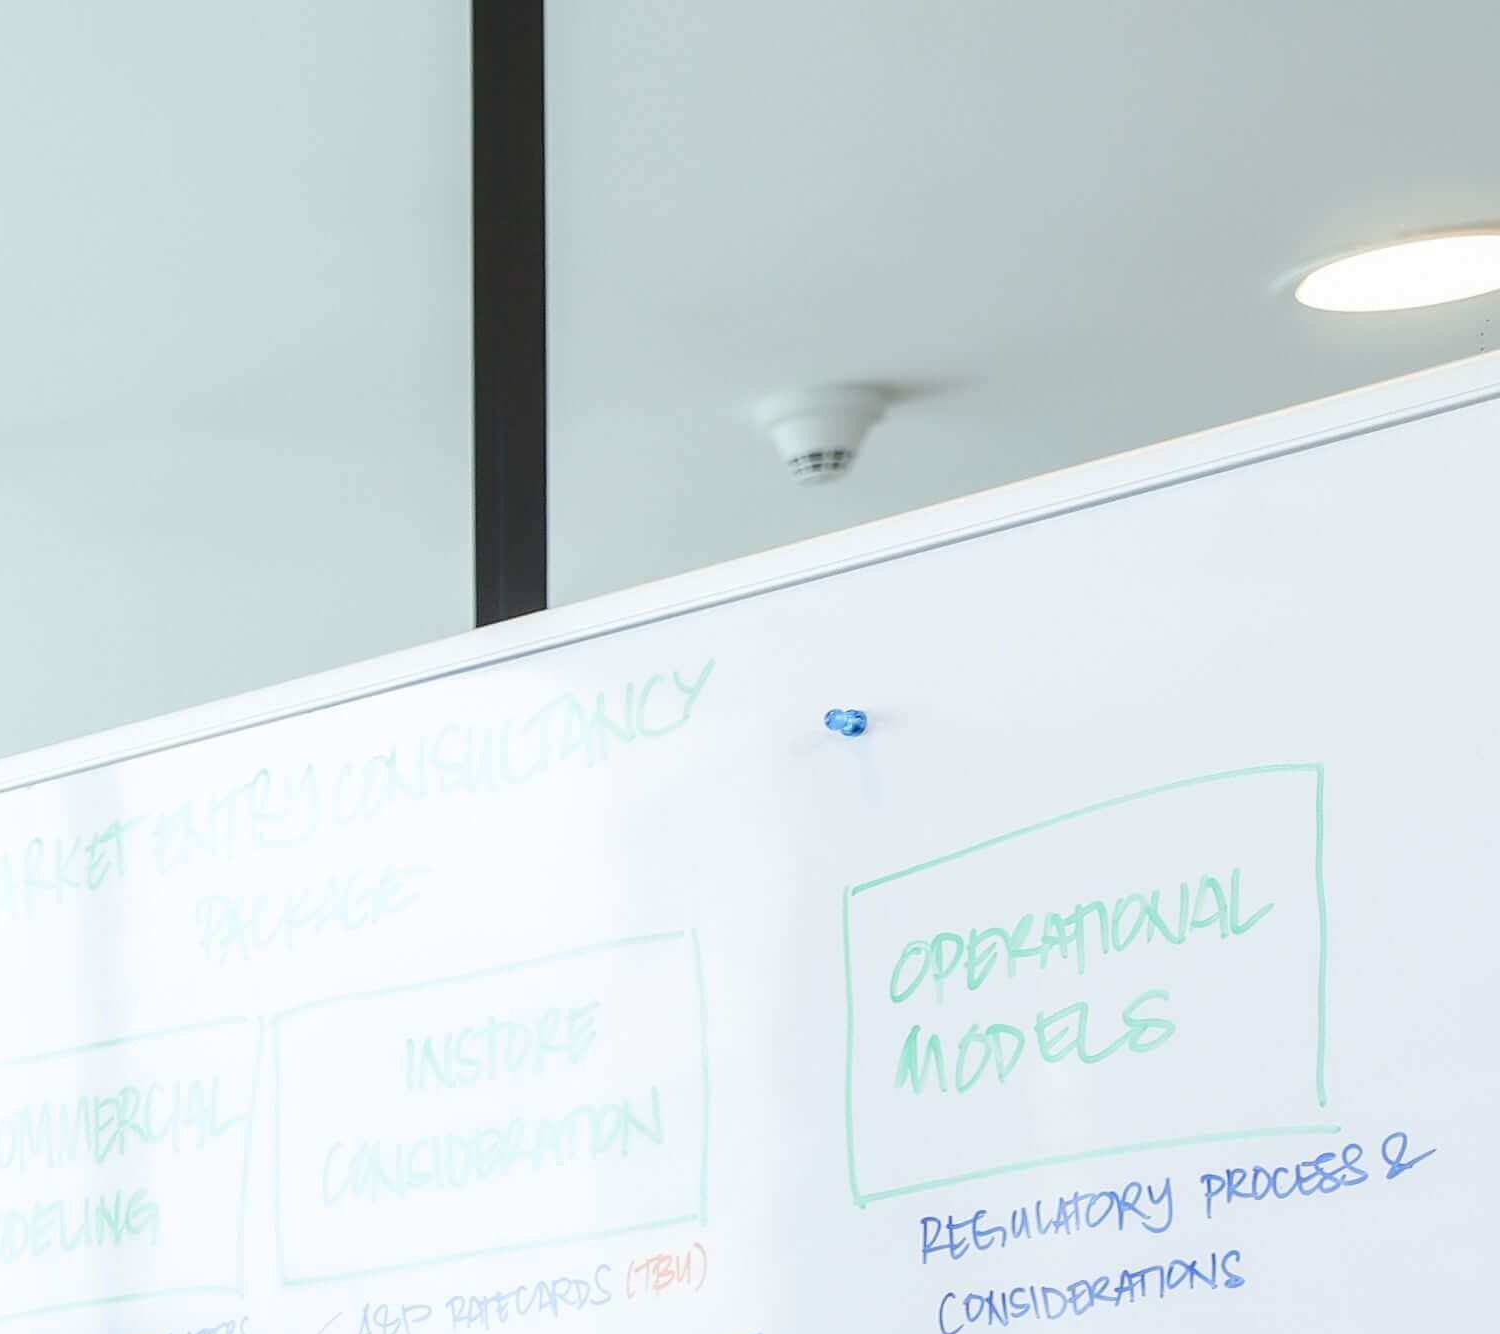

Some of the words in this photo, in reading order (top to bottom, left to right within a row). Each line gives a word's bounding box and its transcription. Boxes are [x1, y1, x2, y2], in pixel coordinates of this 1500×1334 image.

[150, 762, 318, 872] ENTRY
[332, 659, 715, 826] CONSULTANCY
[194, 864, 431, 966] PACKAGE
[889, 867, 1274, 1003] OPERATIONAL
[405, 1002, 602, 1090] INSTORE
[896, 989, 1176, 1094] MODELS
[320, 1085, 665, 1207] CONSIDERATION
[920, 1177, 1175, 1264] REGULATORY
[1201, 1143, 1370, 1219] PROCESS
[1382, 1132, 1436, 1179] &
